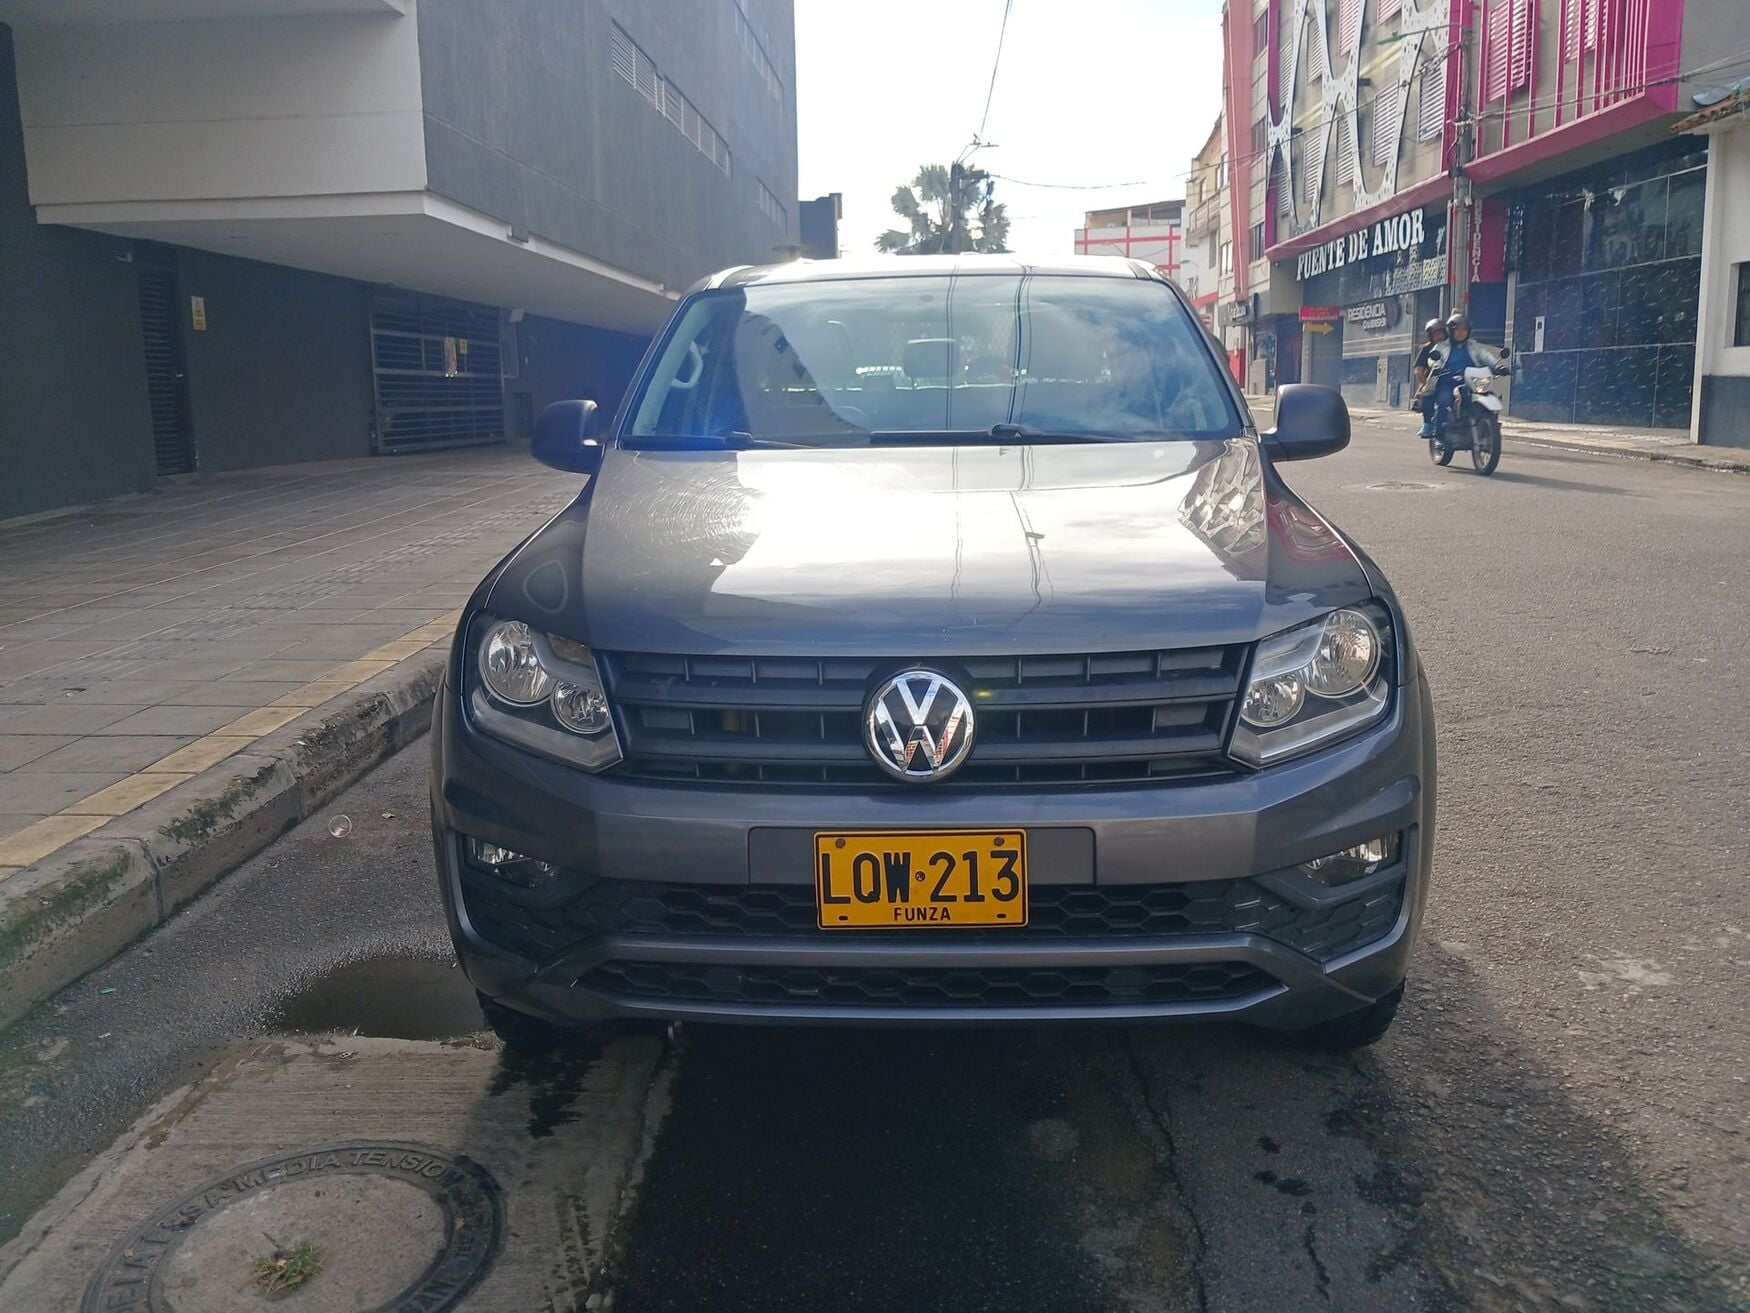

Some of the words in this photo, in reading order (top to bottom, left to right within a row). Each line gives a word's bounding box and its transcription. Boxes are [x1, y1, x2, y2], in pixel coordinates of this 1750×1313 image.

[1348, 230, 1368, 264] DE
[1372, 208, 1424, 256] AMOR
[929, 850, 1020, 902] 213
[893, 906, 951, 921] FUNZA
[232, 1153, 341, 1193] MEDIA
